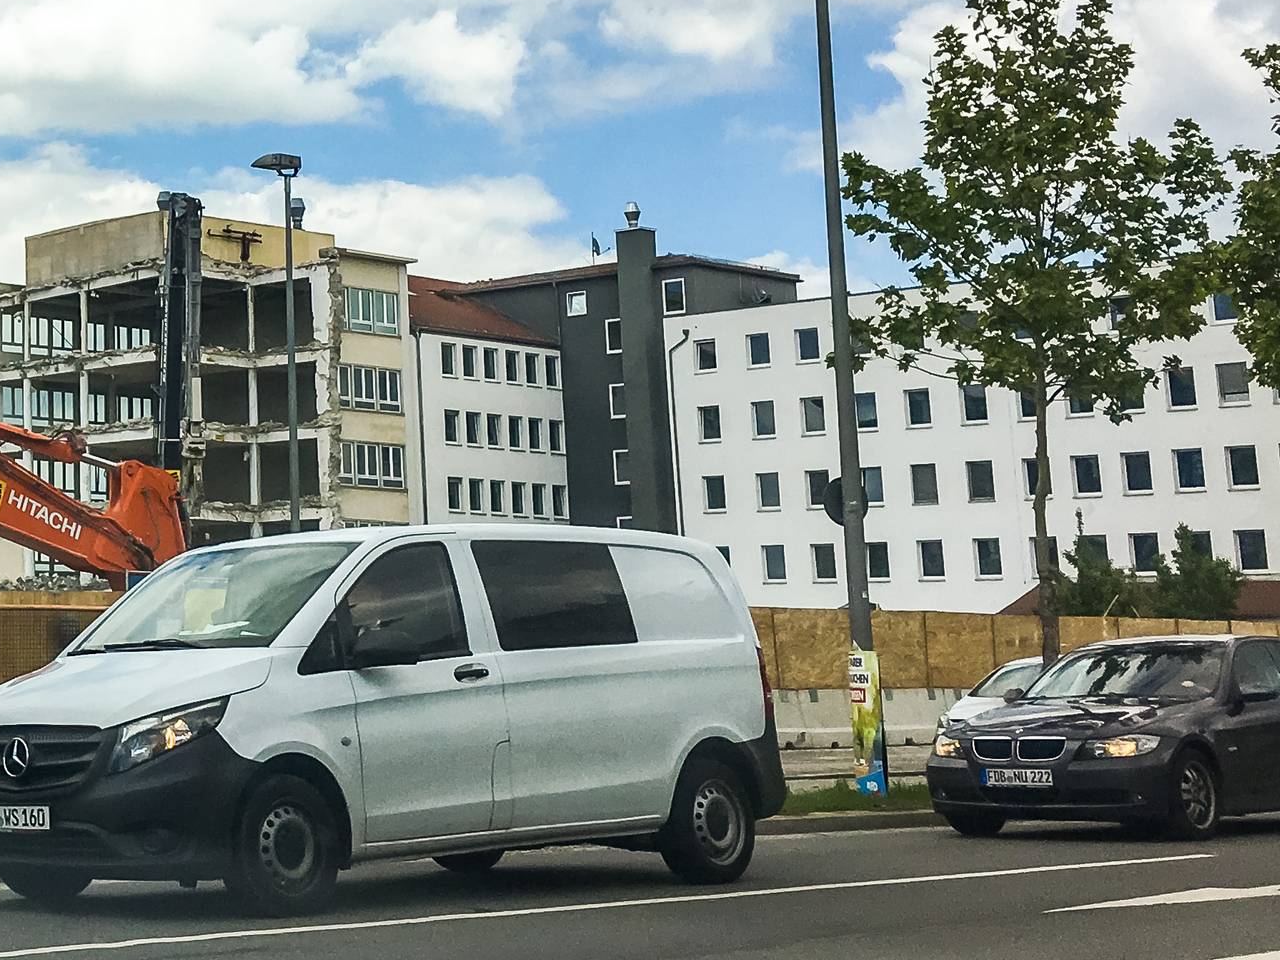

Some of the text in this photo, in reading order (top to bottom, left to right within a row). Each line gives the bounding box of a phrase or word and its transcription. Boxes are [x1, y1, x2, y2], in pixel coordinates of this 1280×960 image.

[7, 489, 82, 541] HITACHI
[1013, 771, 1028, 784] NU
[1030, 771, 1052, 784] 222
[22, 808, 45, 828] 160
